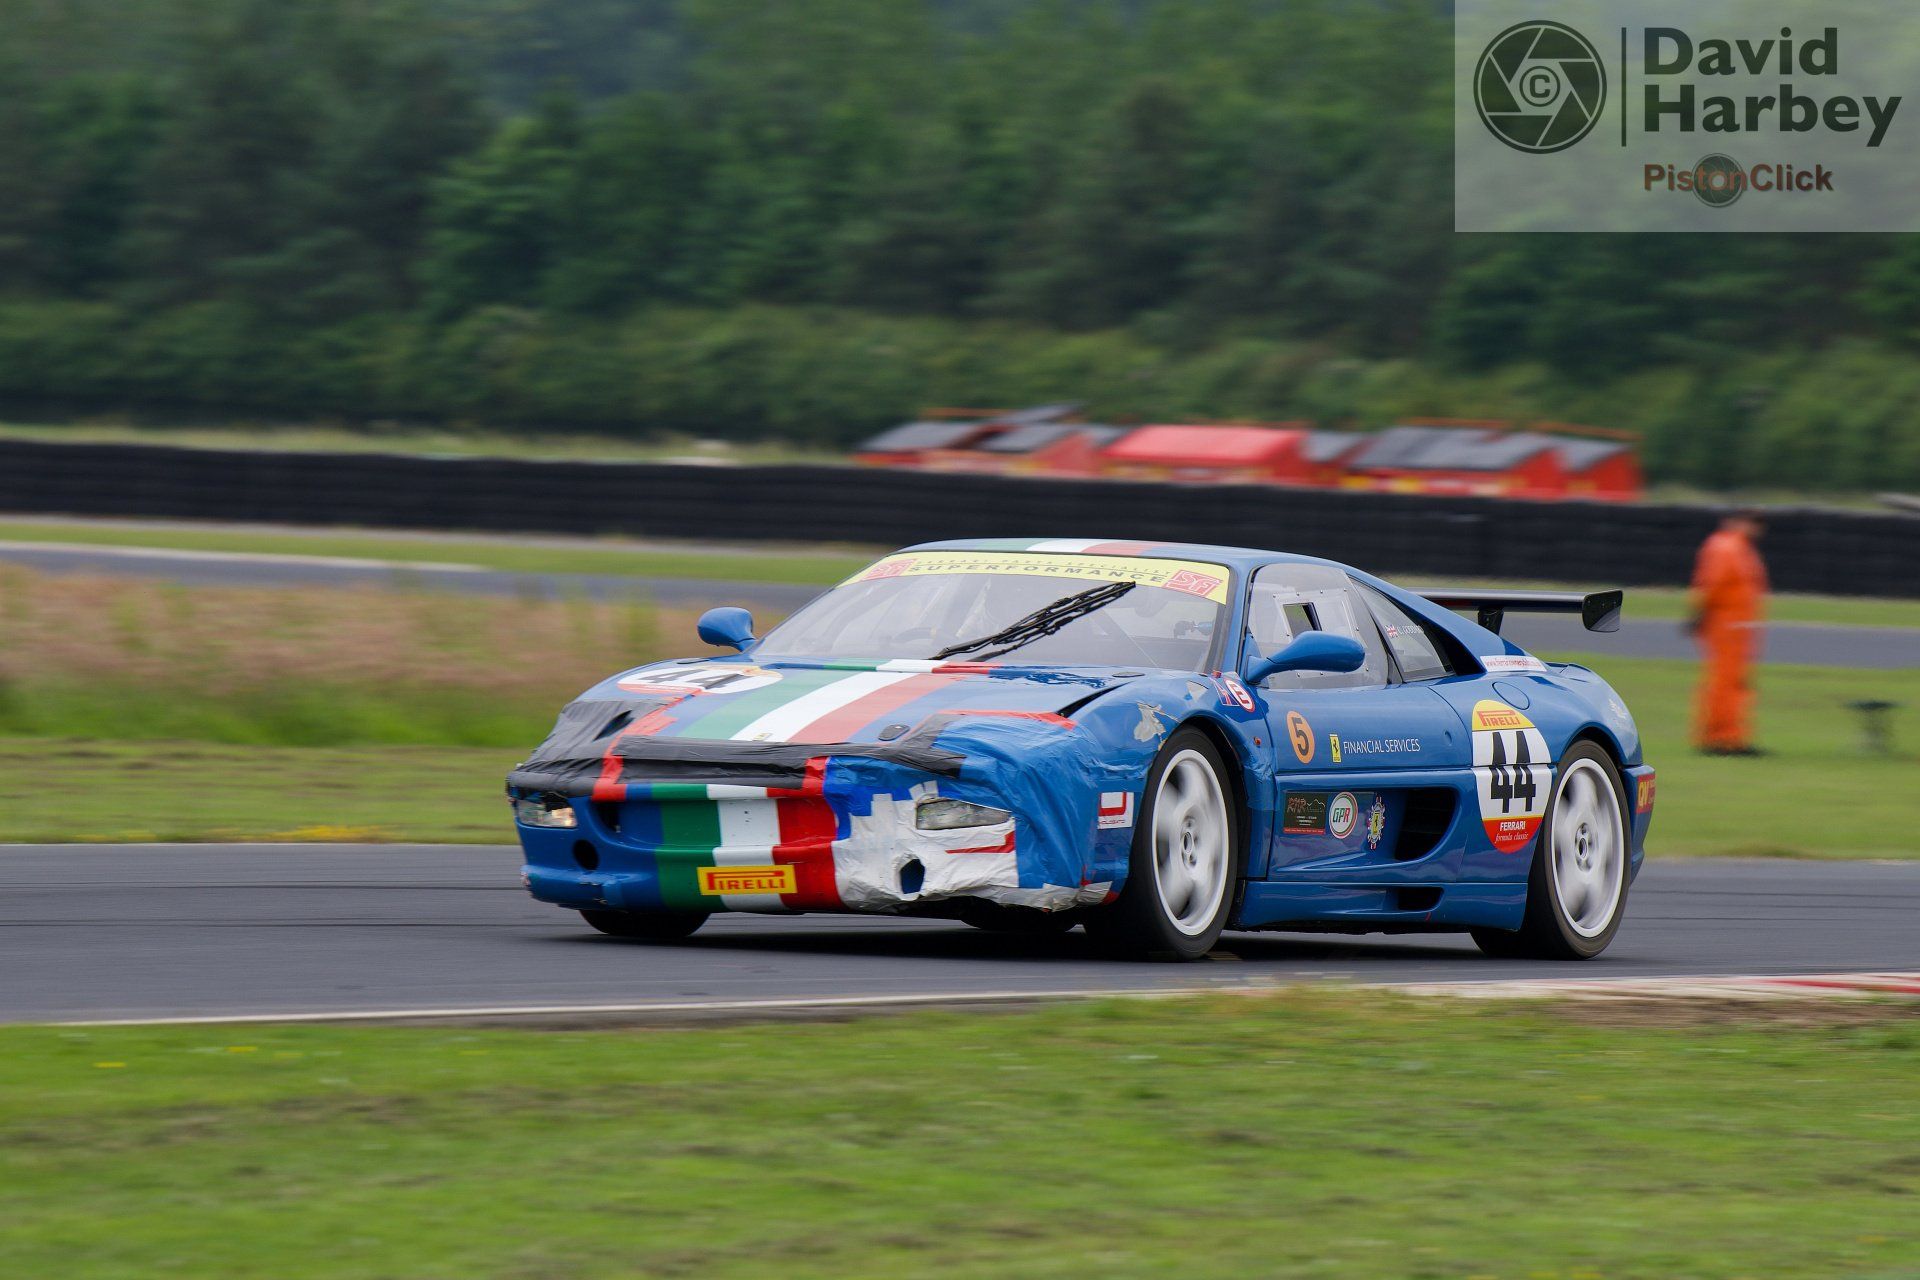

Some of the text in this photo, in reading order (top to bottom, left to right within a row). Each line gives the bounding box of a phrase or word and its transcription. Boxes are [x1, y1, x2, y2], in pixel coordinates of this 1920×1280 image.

[908, 564, 1164, 582] SUPERFORMANCE
[637, 668, 753, 690] 44
[1477, 710, 1521, 727] PIRELLI
[1292, 717, 1310, 756] 5
[1343, 738, 1421, 754] FINANCIAL SERVICES
[1490, 731, 1537, 813] 44
[1332, 807, 1351, 823] GPR
[1499, 821, 1526, 831] FERRARI
[706, 870, 785, 891] PIRELLI
